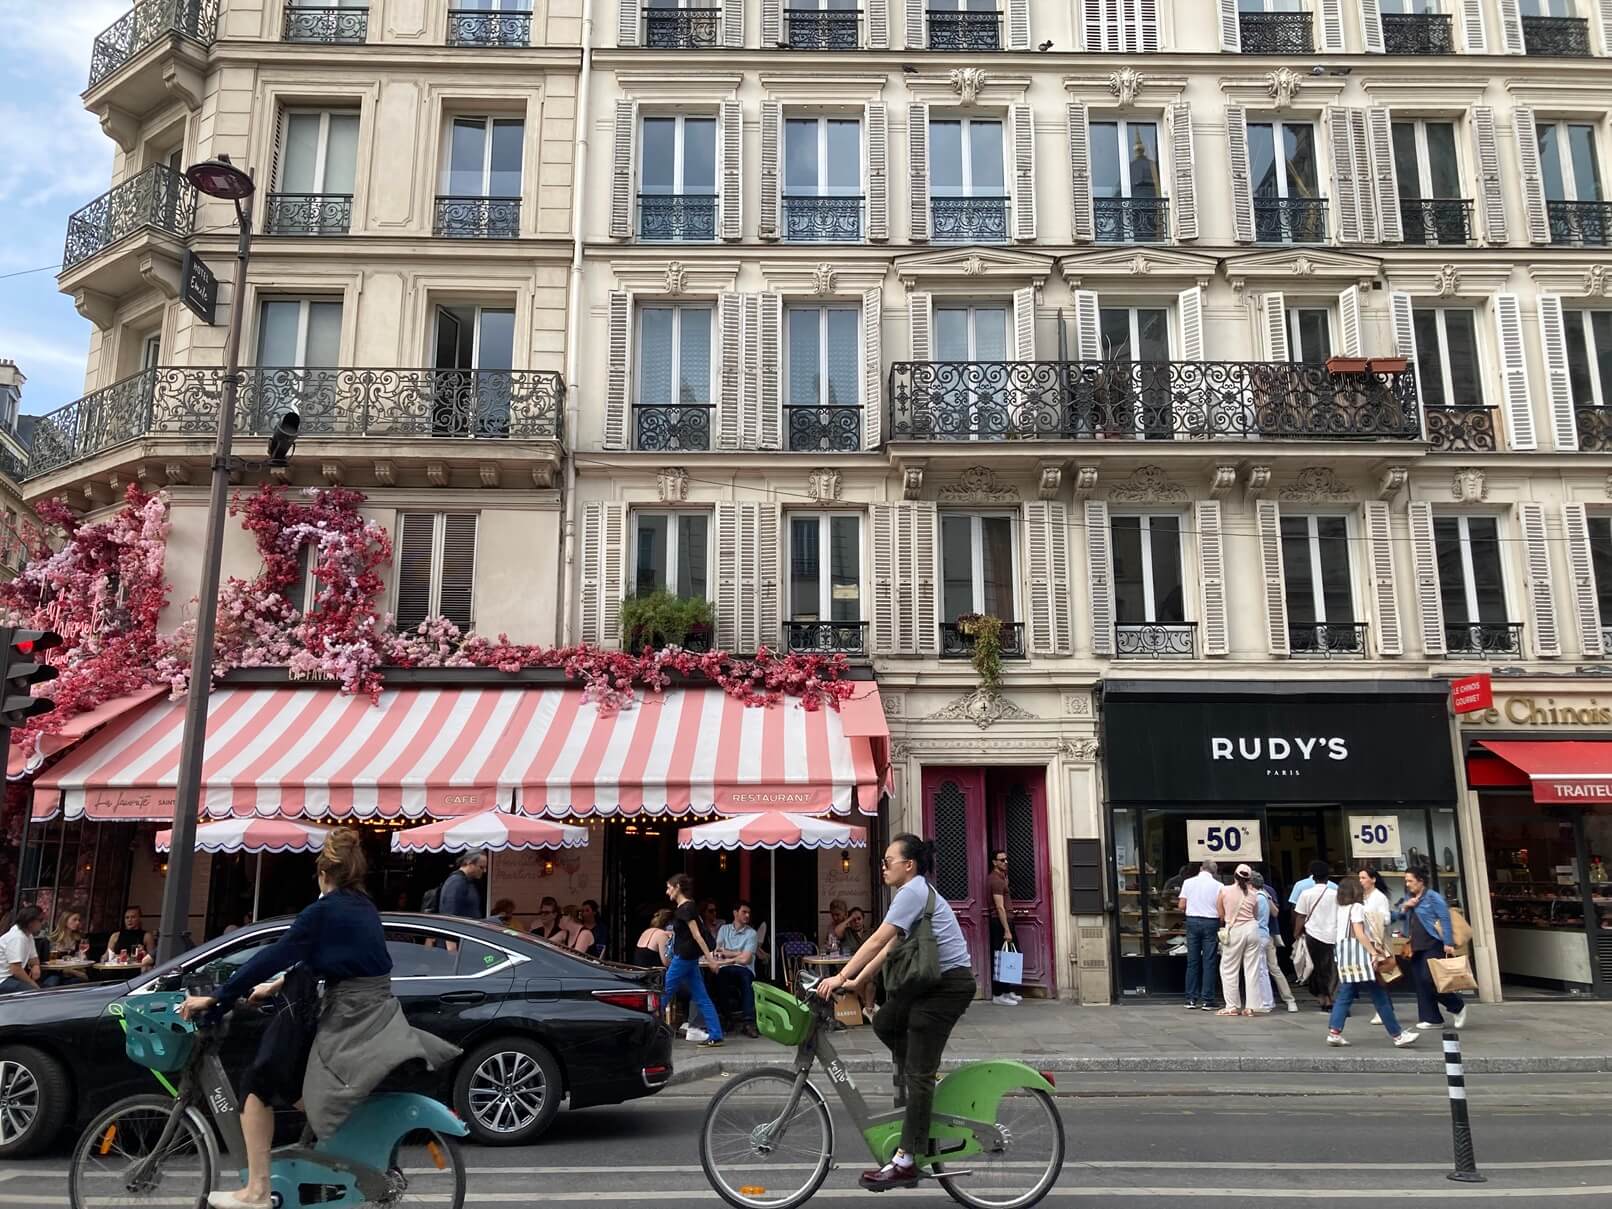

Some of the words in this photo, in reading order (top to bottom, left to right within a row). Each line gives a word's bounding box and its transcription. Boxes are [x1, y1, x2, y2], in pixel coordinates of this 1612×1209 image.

[1504, 695, 1612, 725] Chinois
[1211, 737, 1349, 760] RUDY'S
[732, 793, 810, 802] RESTAURANT
[1197, 826, 1250, 852] -50%
